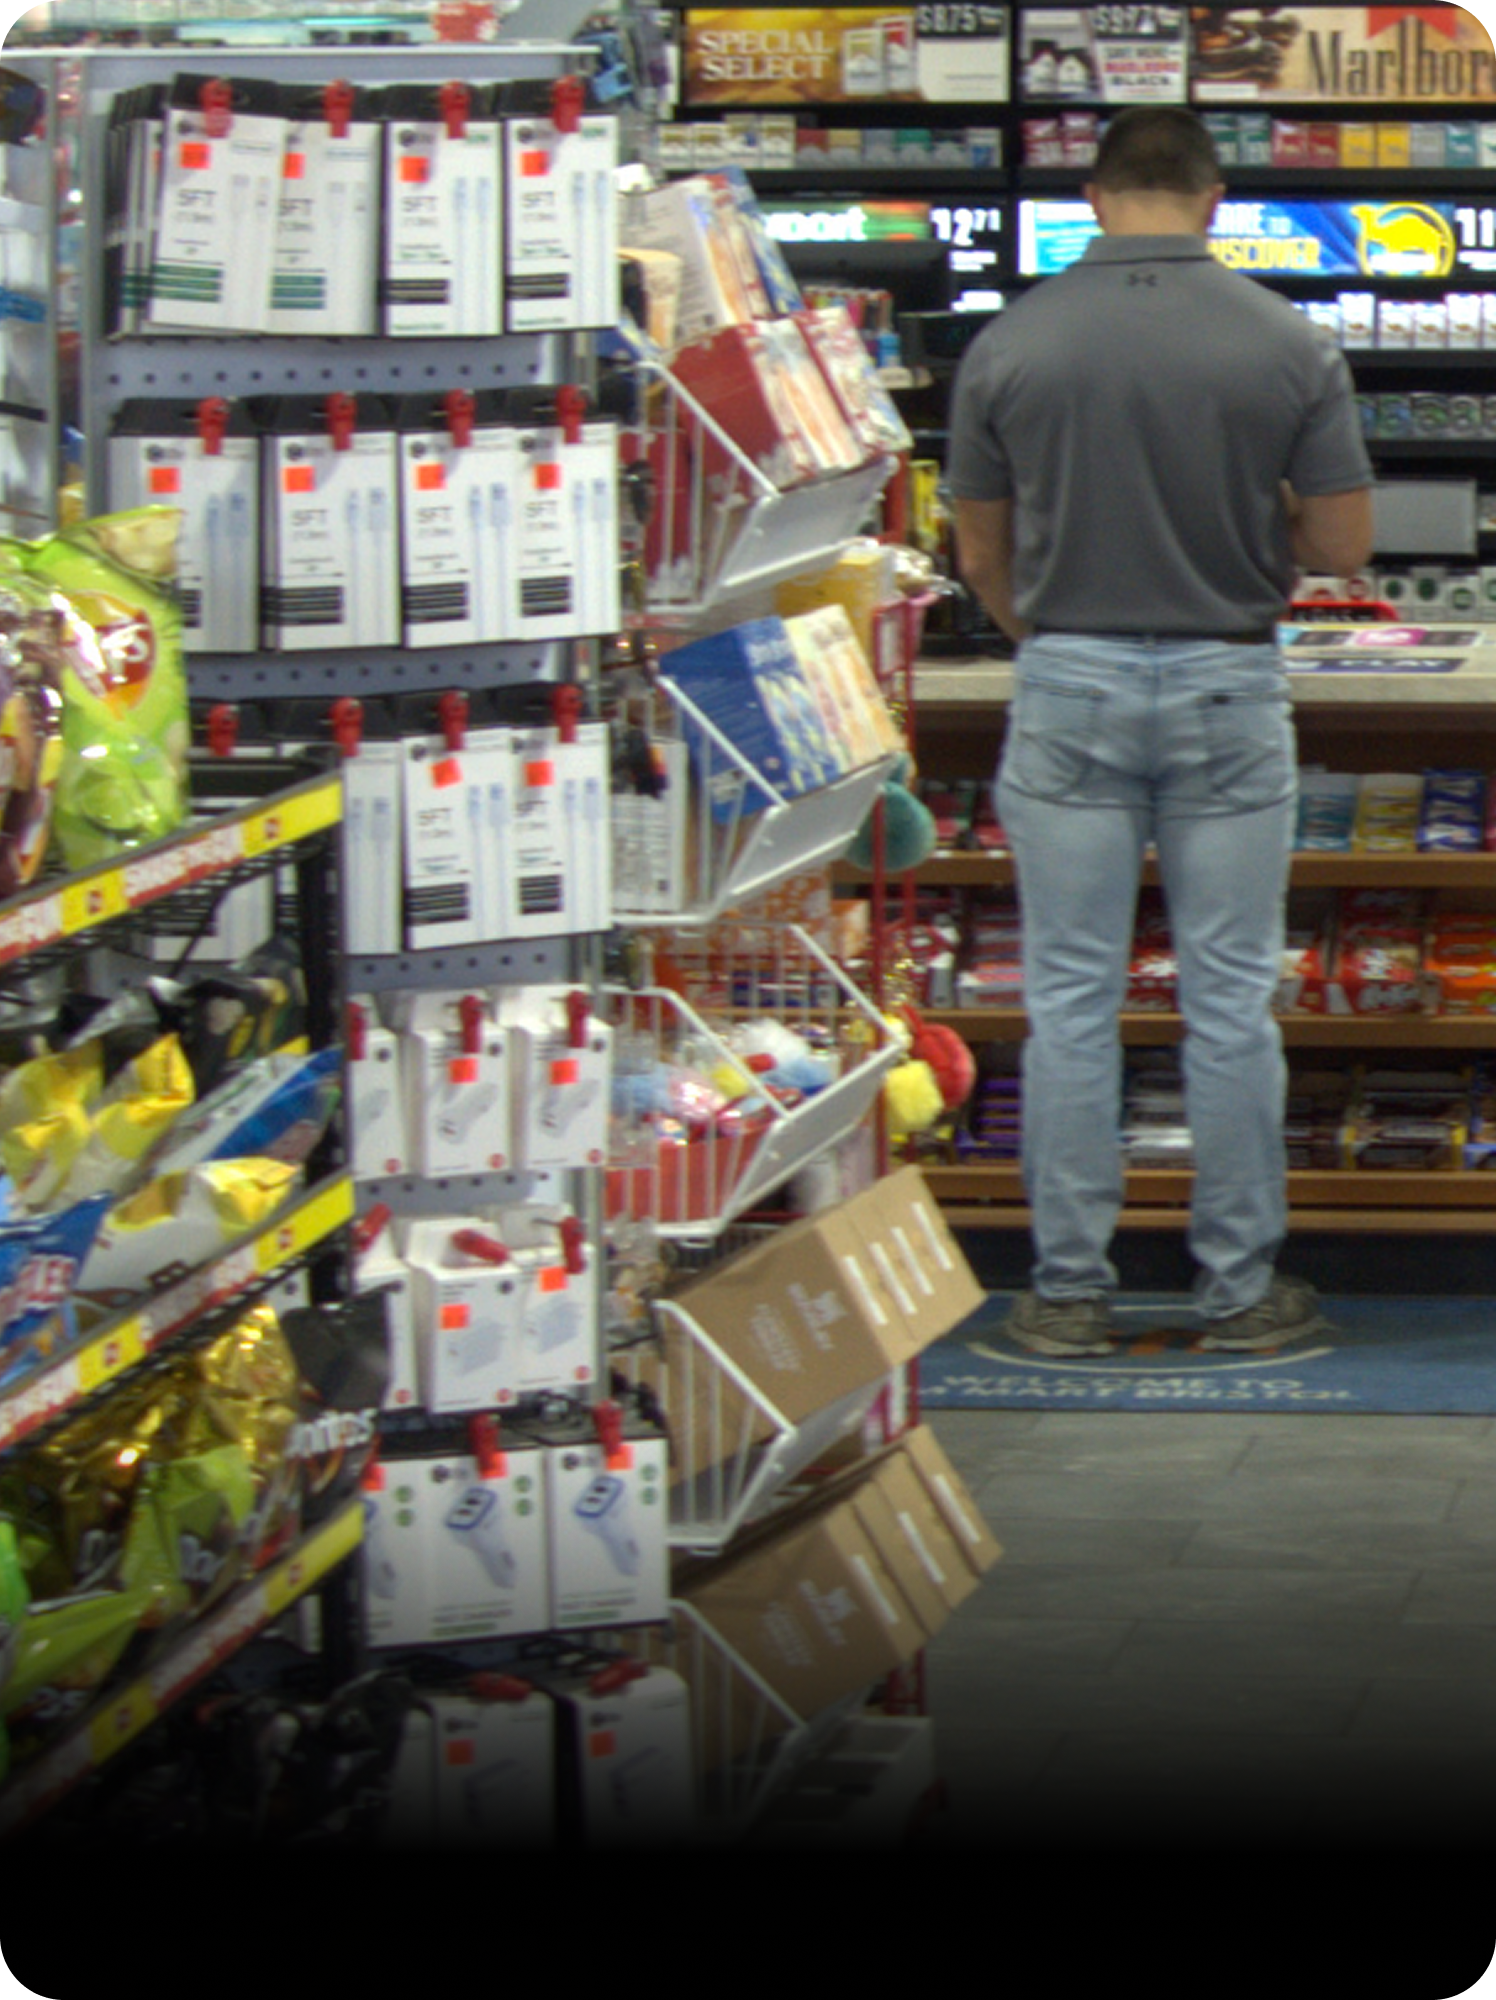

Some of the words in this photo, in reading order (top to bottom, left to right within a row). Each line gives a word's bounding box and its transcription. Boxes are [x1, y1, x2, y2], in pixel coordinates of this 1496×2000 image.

[698, 29, 834, 55] SPECIAL
[1307, 13, 1496, 96] Marlbor
[702, 55, 830, 82] SELECT
[943, 1374, 1216, 1389] WELCOME
[1236, 1377, 1305, 1390] TO
[1132, 1386, 1358, 1400] BRISTOL
